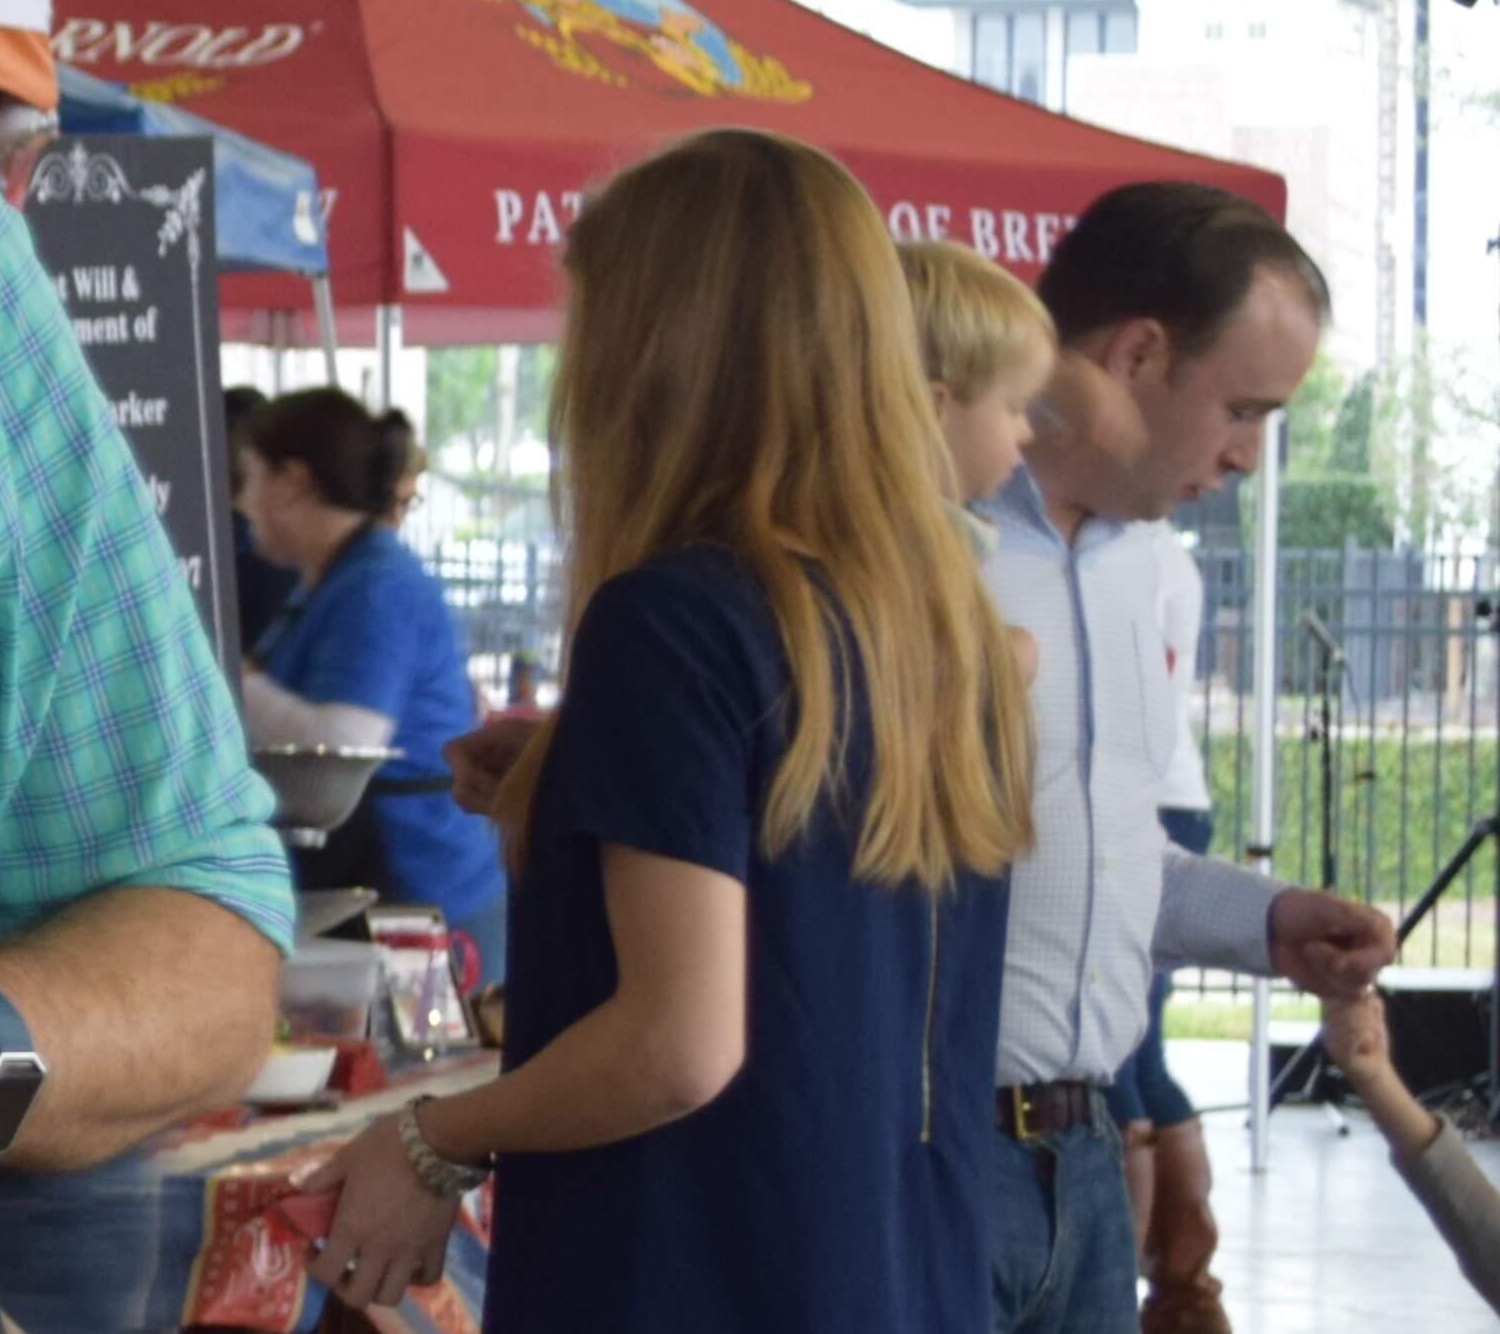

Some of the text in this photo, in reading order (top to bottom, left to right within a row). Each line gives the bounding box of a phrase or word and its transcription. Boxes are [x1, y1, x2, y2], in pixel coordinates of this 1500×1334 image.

[51, 17, 303, 66] RNOLD
[493, 189, 1079, 264] PAT OF BRE
[73, 266, 117, 302] Will
[122, 264, 141, 301] &
[134, 305, 159, 343] of
